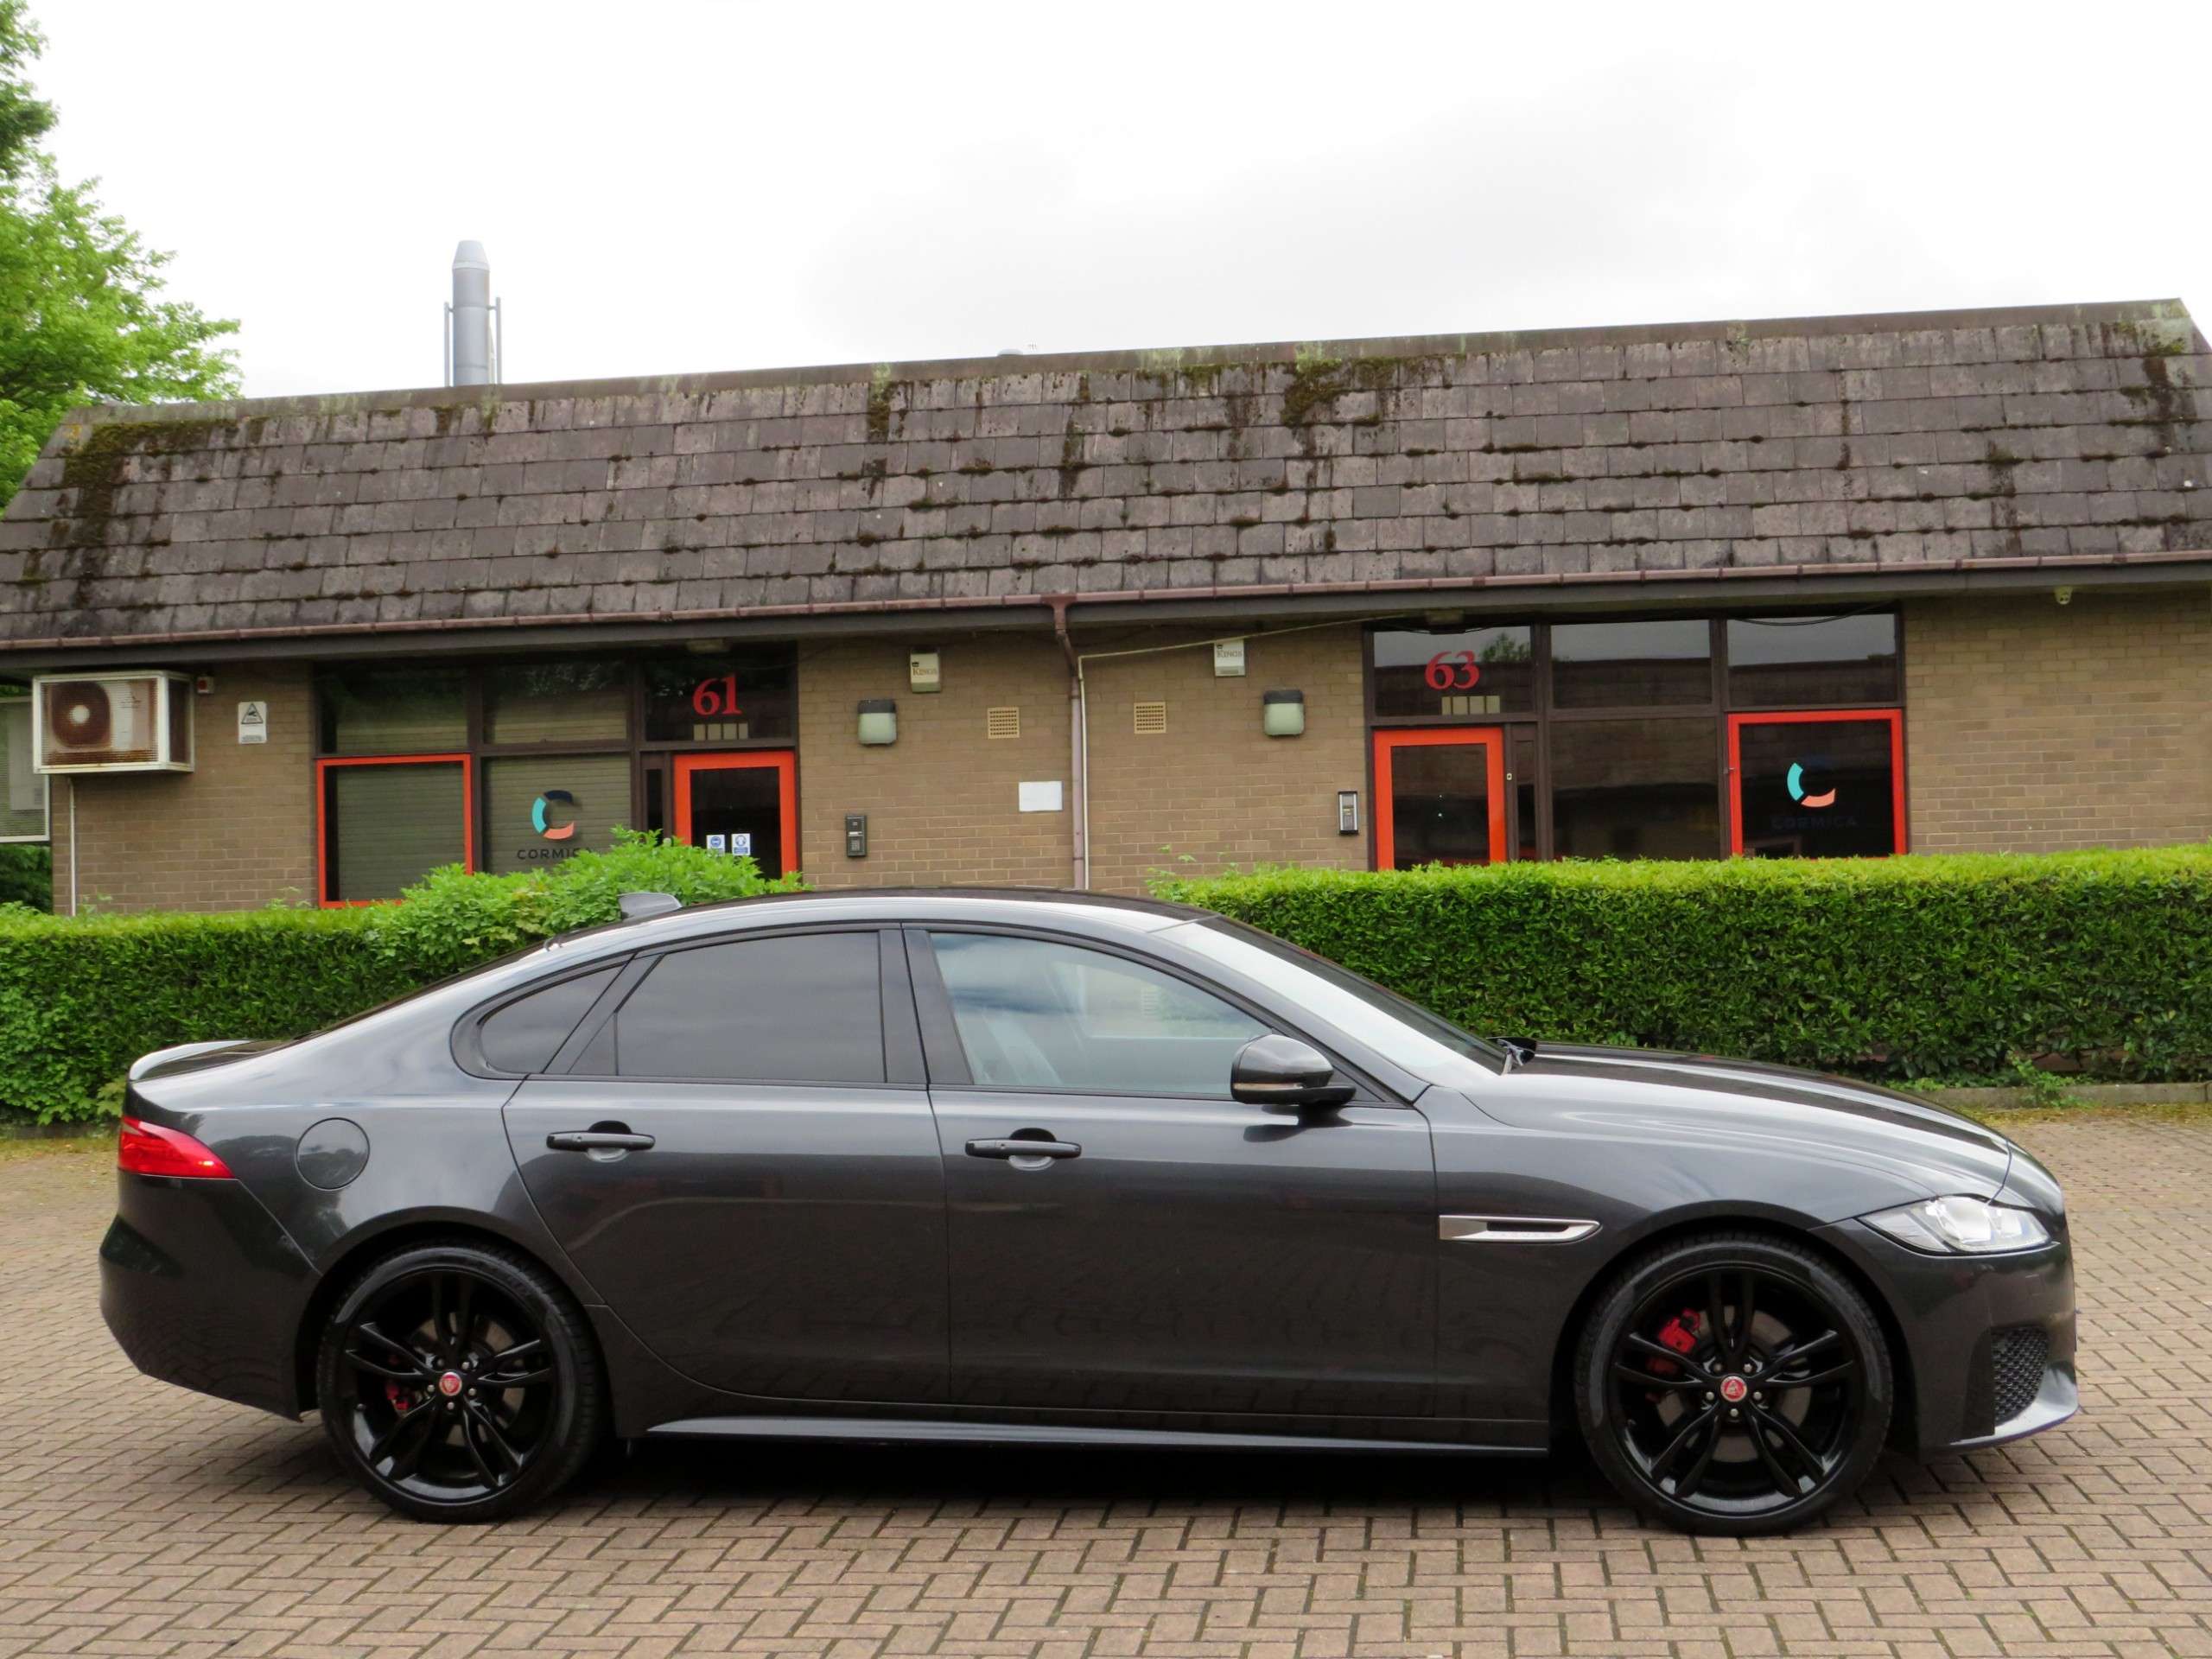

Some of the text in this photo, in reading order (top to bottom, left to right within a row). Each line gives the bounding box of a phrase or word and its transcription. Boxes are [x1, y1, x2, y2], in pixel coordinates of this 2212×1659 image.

[1425, 650, 1479, 690] 63
[693, 675, 743, 715] 61
[517, 847, 593, 860] CORMIC
